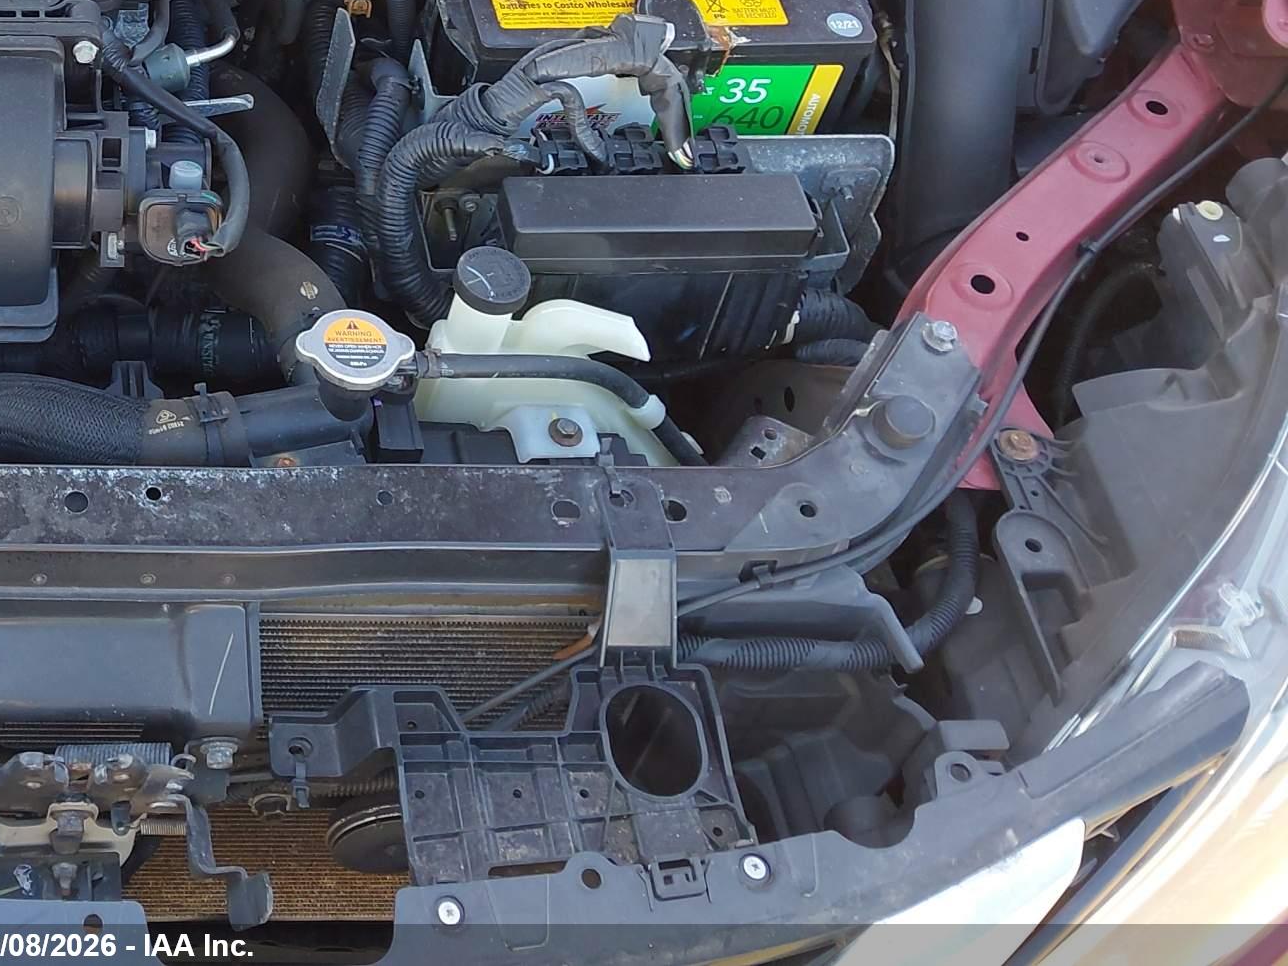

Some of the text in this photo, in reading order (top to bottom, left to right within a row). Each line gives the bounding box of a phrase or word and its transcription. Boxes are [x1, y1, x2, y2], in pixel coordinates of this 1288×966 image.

[499, 1, 541, 10] batteries
[554, 1, 584, 9] Costco
[587, 0, 635, 8] Wholesale
[829, 20, 859, 30] 12/21
[719, 78, 772, 104] 35
[712, 106, 784, 129] 640
